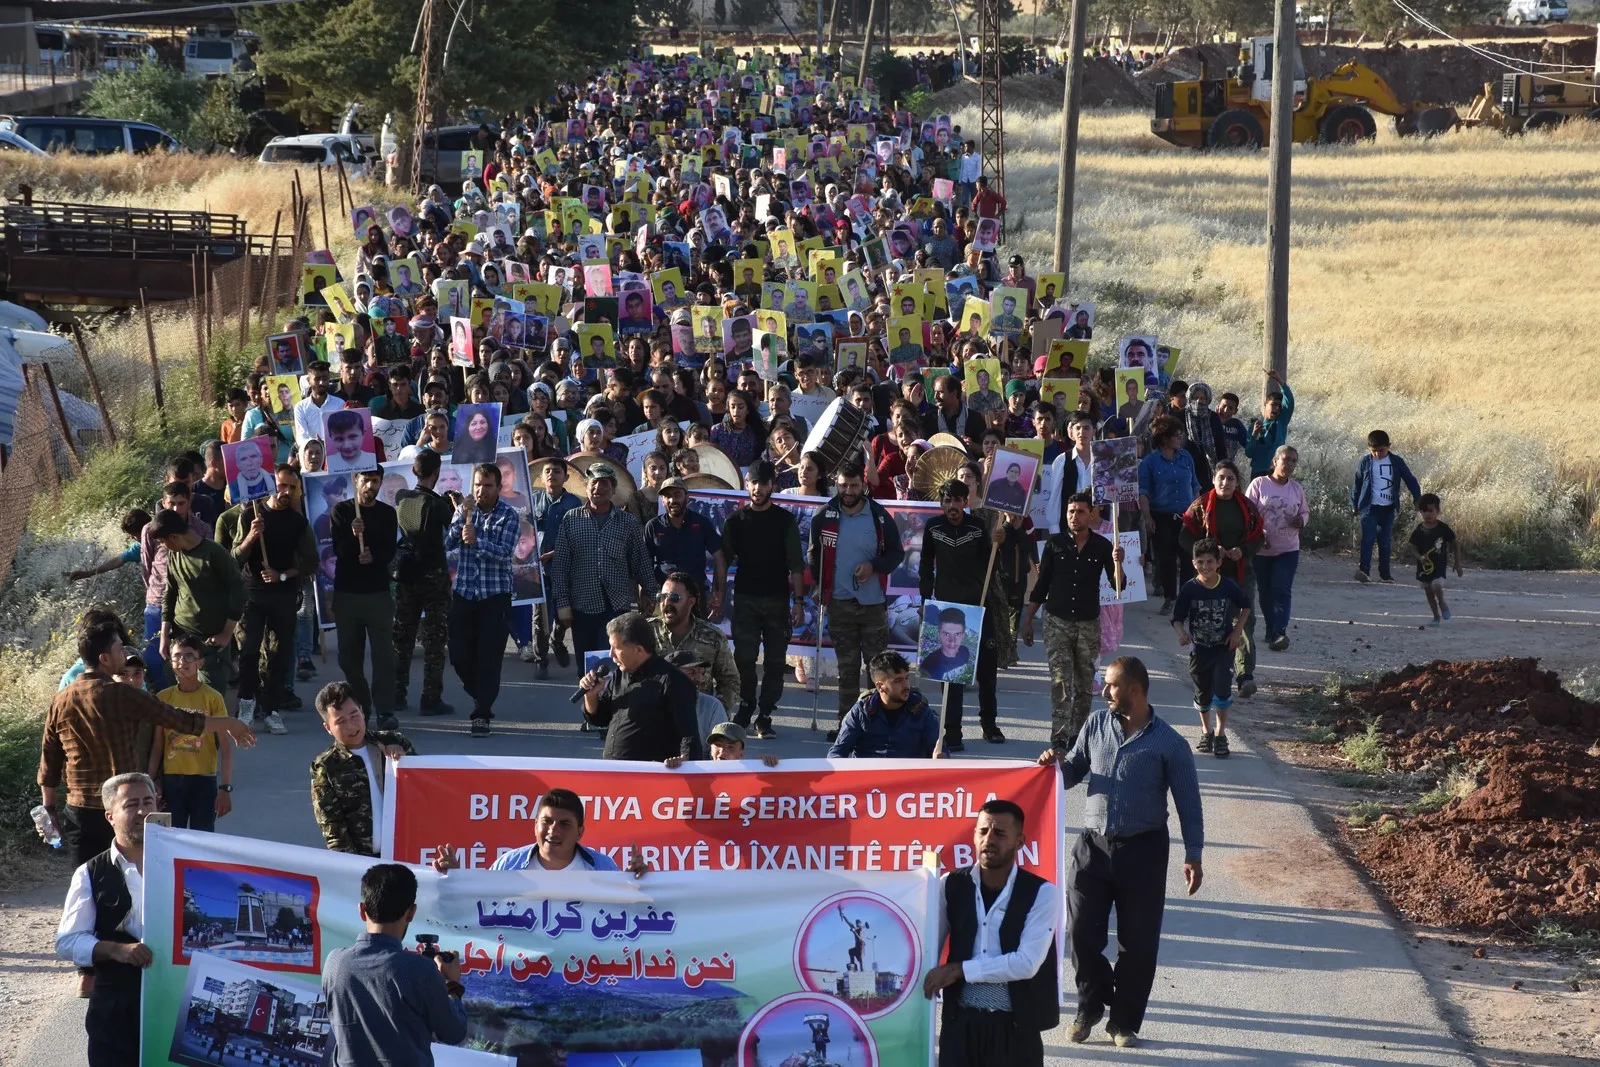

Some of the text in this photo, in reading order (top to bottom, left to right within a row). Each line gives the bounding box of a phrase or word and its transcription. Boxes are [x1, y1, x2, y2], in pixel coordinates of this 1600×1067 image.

[469, 794, 499, 820] BI
[508, 794, 643, 821] RTIYA
[651, 791, 731, 820] GELÊ
[738, 794, 858, 827] ŞERKER
[866, 788, 887, 819] Û
[719, 839, 741, 871] Û
[748, 839, 882, 871] ÎXANETÊ
[476, 899, 677, 940] عفرين كرامتنا
[460, 933, 736, 988] نحن فدائيون من أجل
